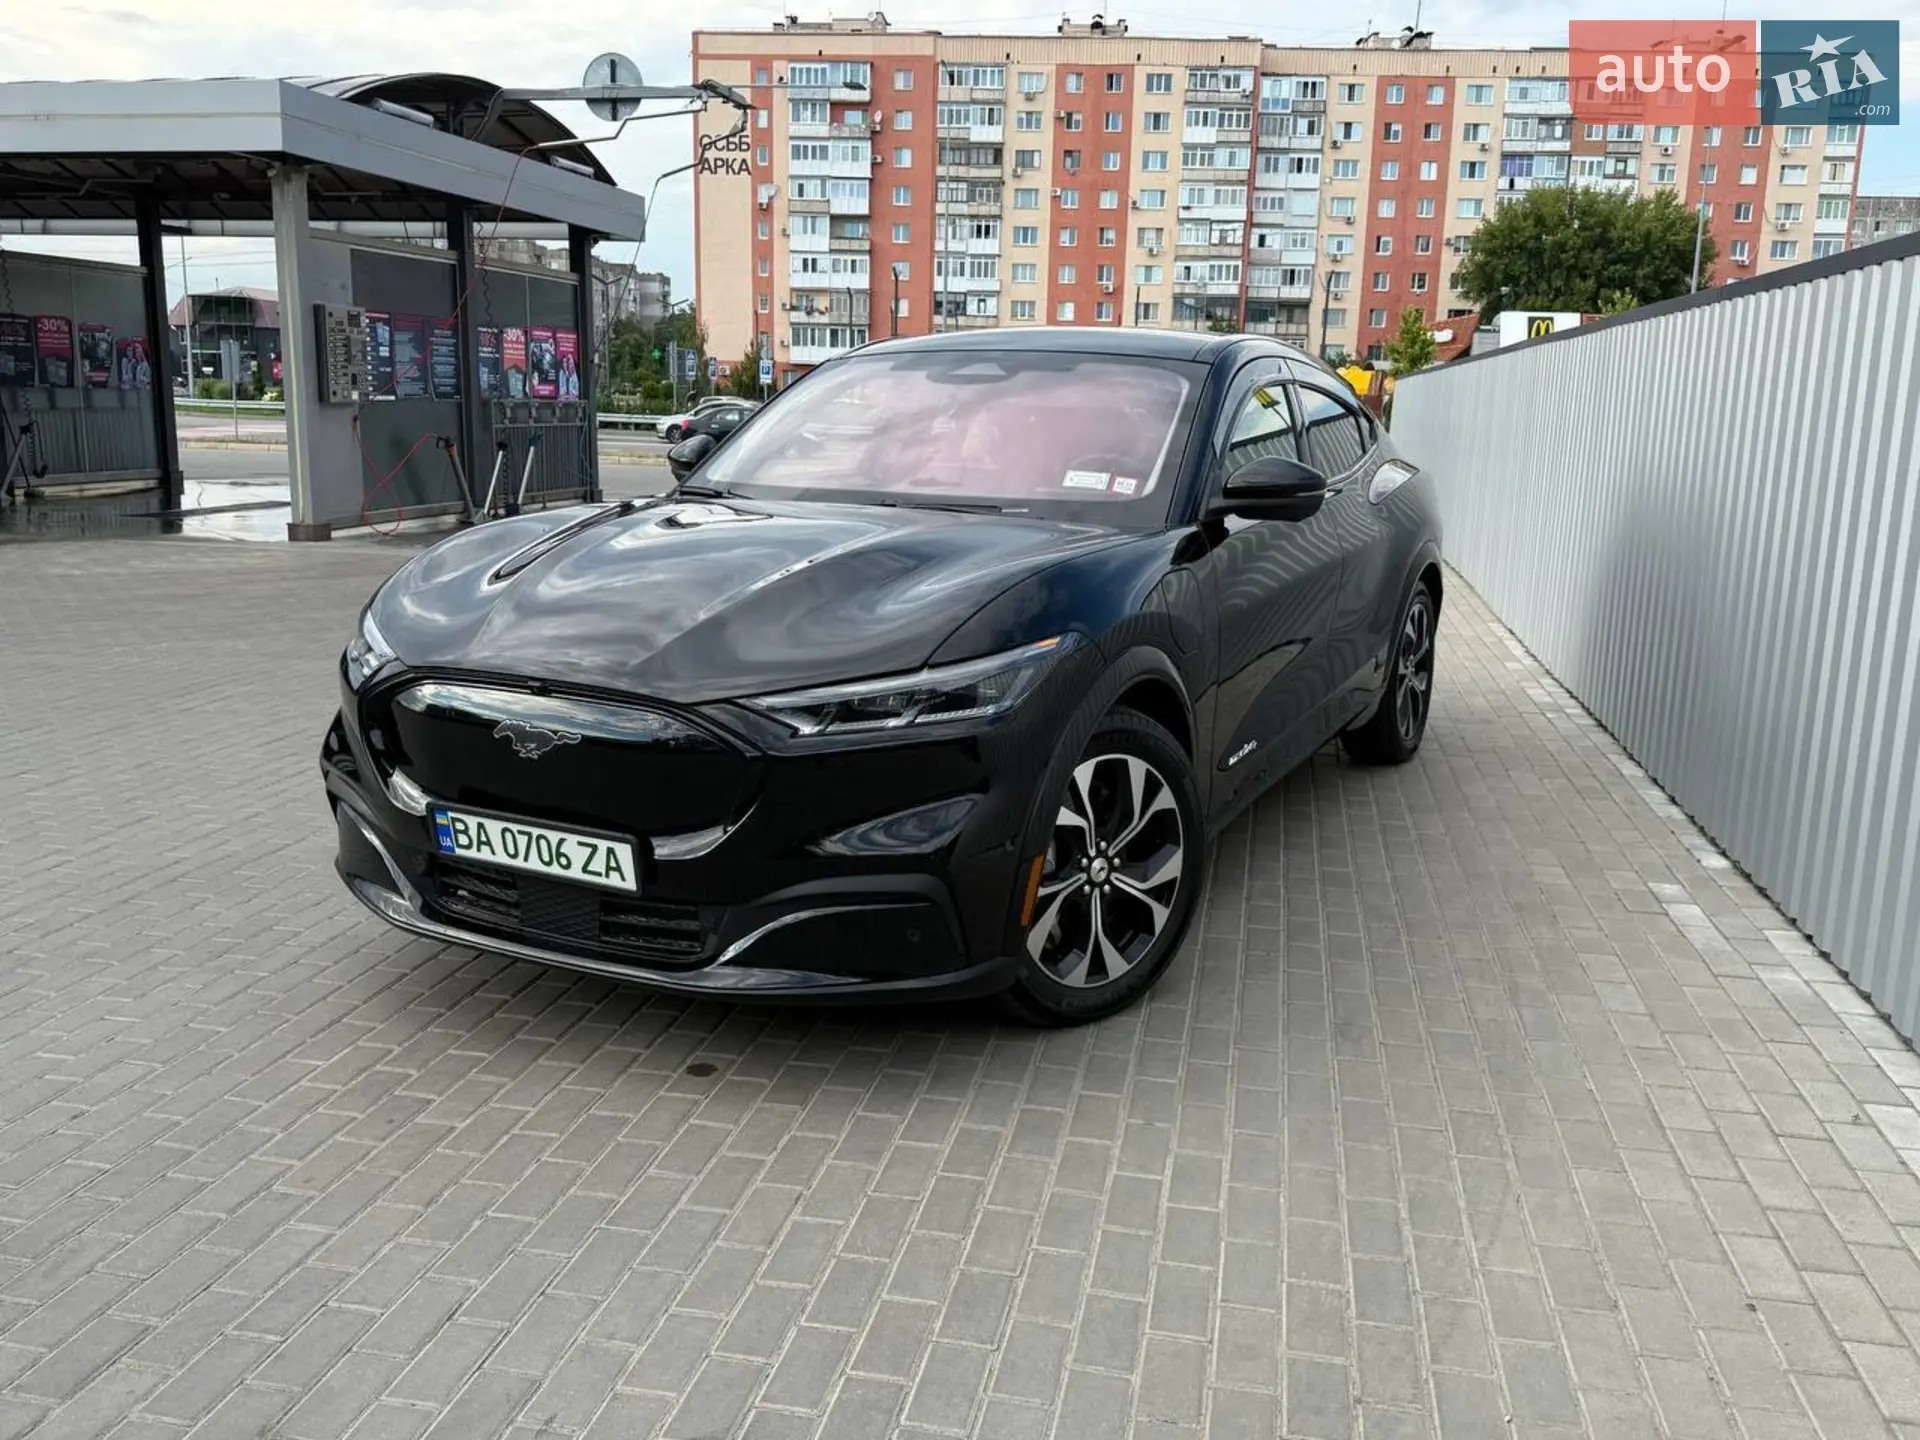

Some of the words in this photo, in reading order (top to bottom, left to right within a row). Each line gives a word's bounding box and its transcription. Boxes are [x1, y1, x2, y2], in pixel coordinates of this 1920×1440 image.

[699, 134, 751, 152] ОСББ
[699, 158, 752, 176] АРКА
[37, 318, 69, 332] -30%
[439, 835, 454, 848] UA
[450, 816, 496, 855] BA
[501, 826, 572, 870] 0706
[577, 840, 626, 882] ZA
